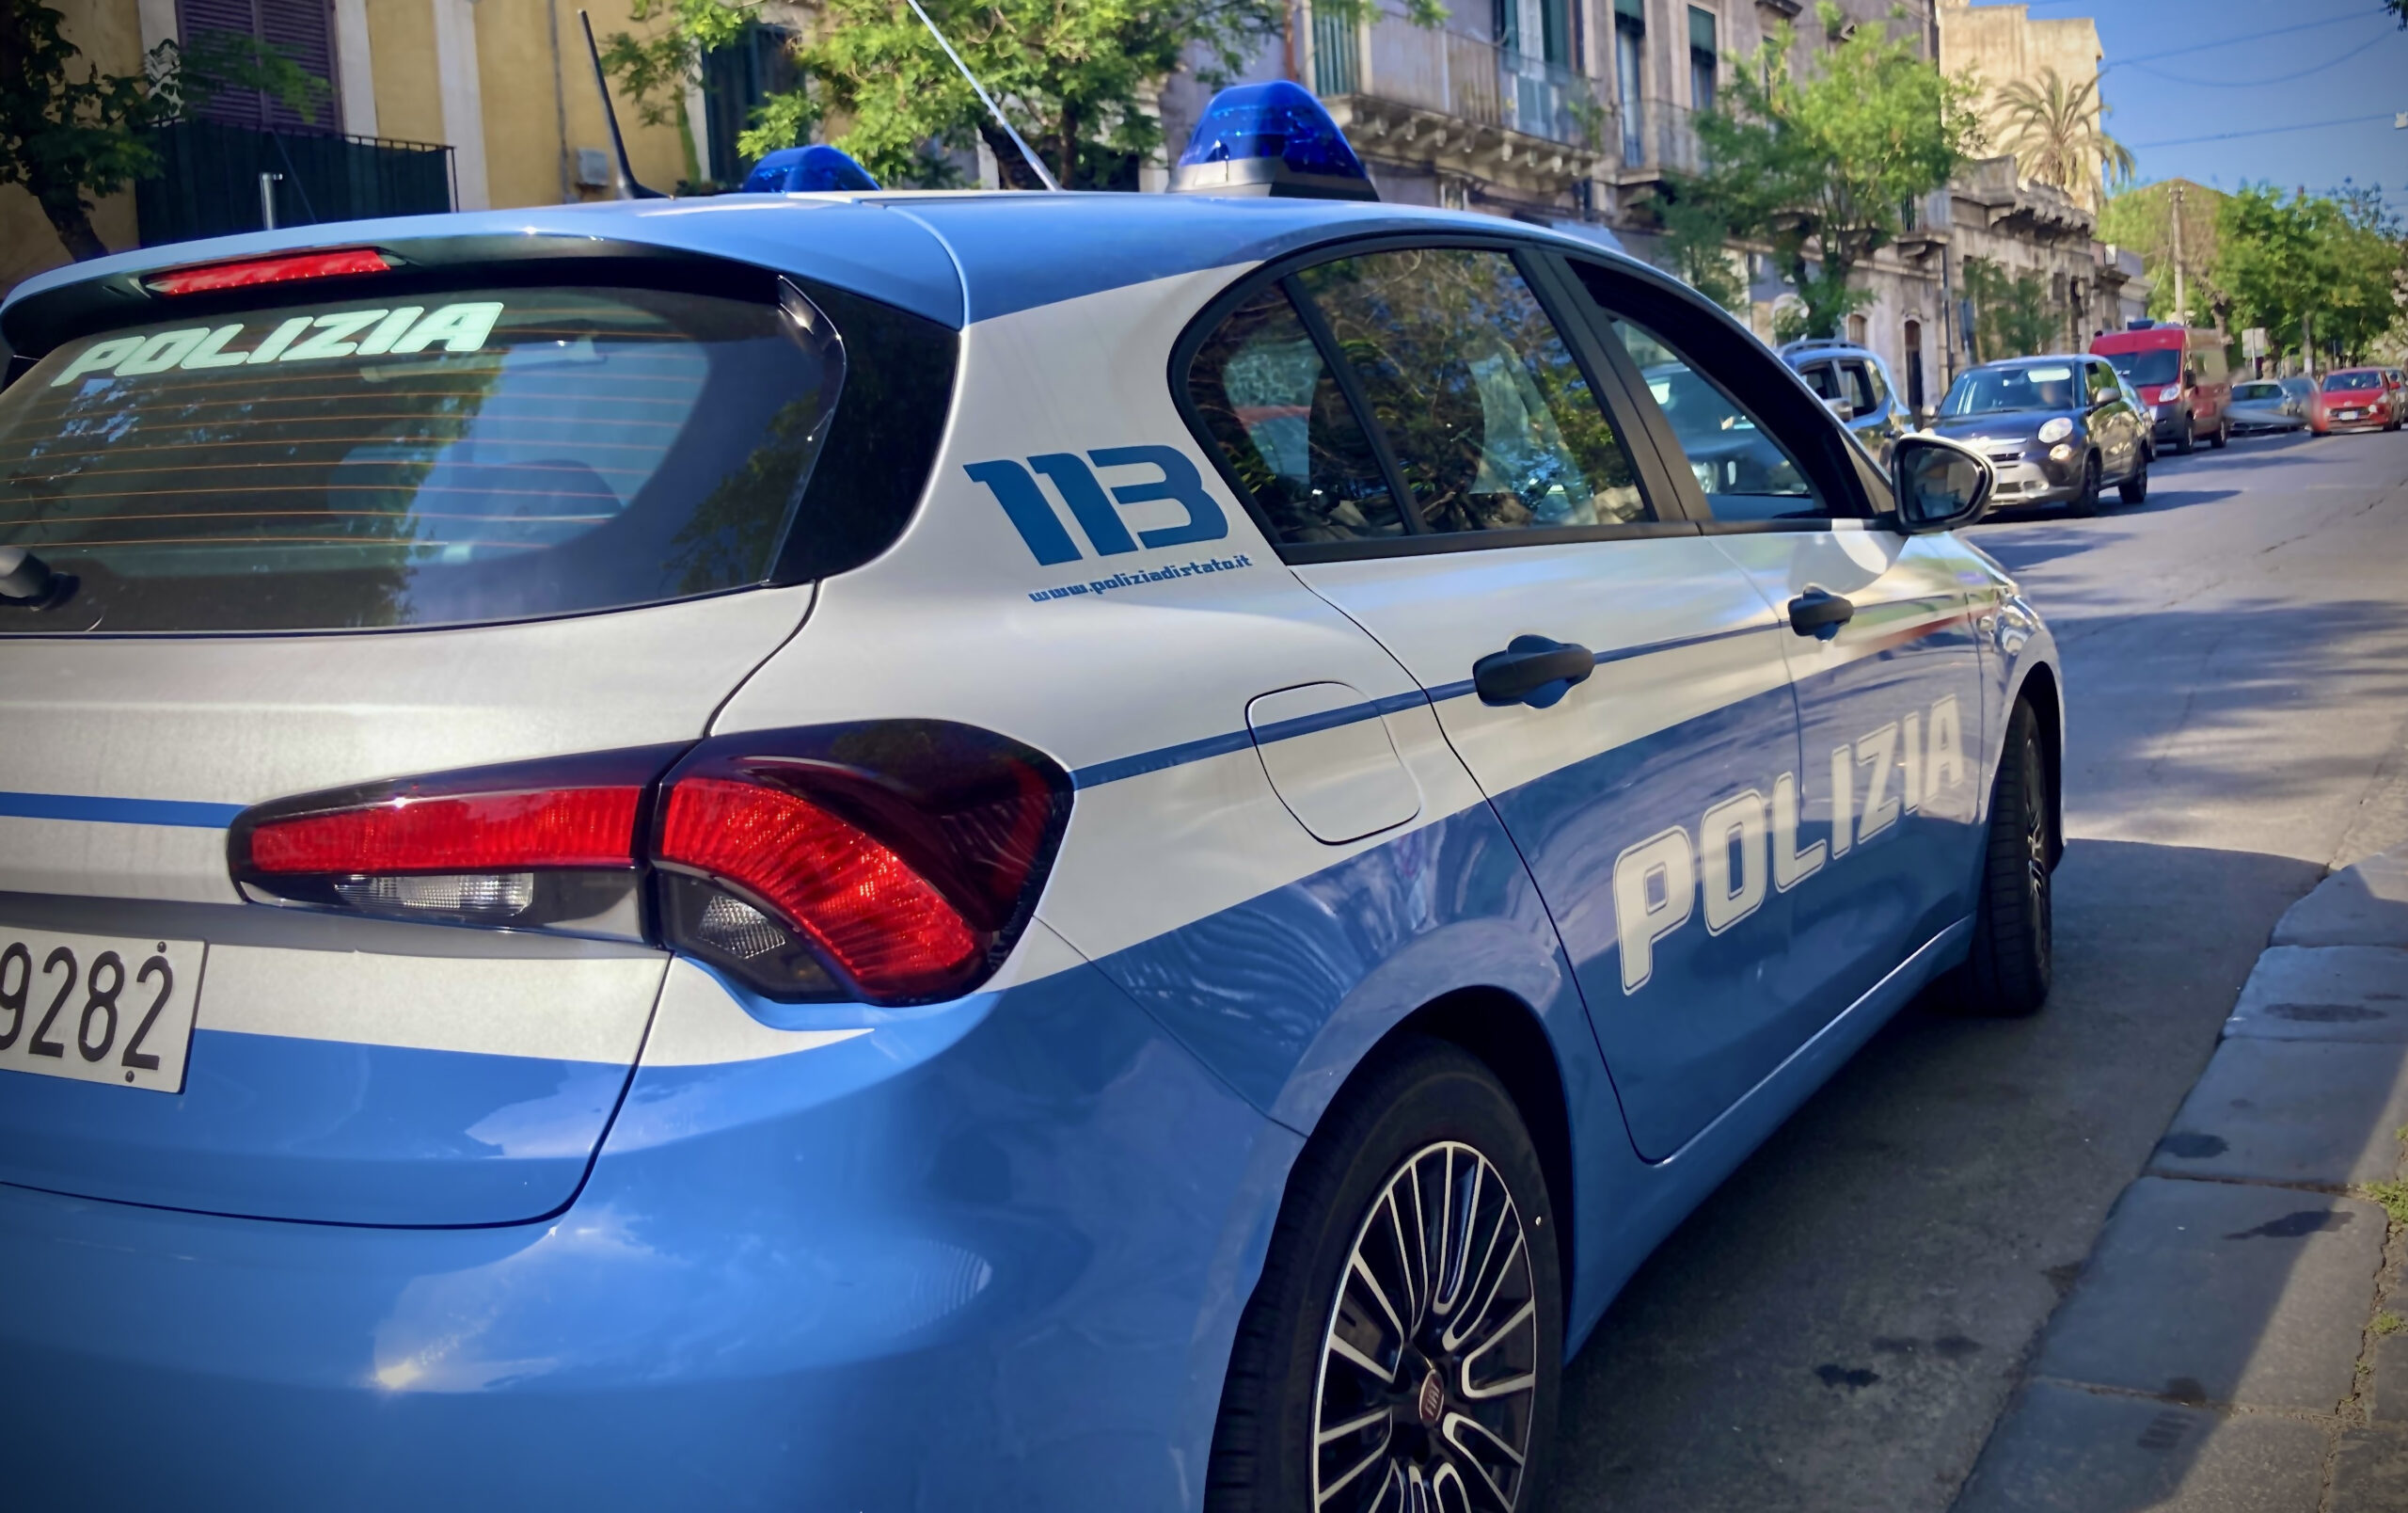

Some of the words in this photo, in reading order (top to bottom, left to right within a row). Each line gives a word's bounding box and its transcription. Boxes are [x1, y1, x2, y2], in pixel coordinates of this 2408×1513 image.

[51, 302, 504, 387] POLIZIA
[962, 444, 1228, 565] 113
[1028, 555, 1253, 602] www.poliziadistato.it
[1612, 693, 1964, 995] POLIZIA
[0, 942, 173, 1070] 9282
[1424, 1380, 1440, 1417] FIAT
